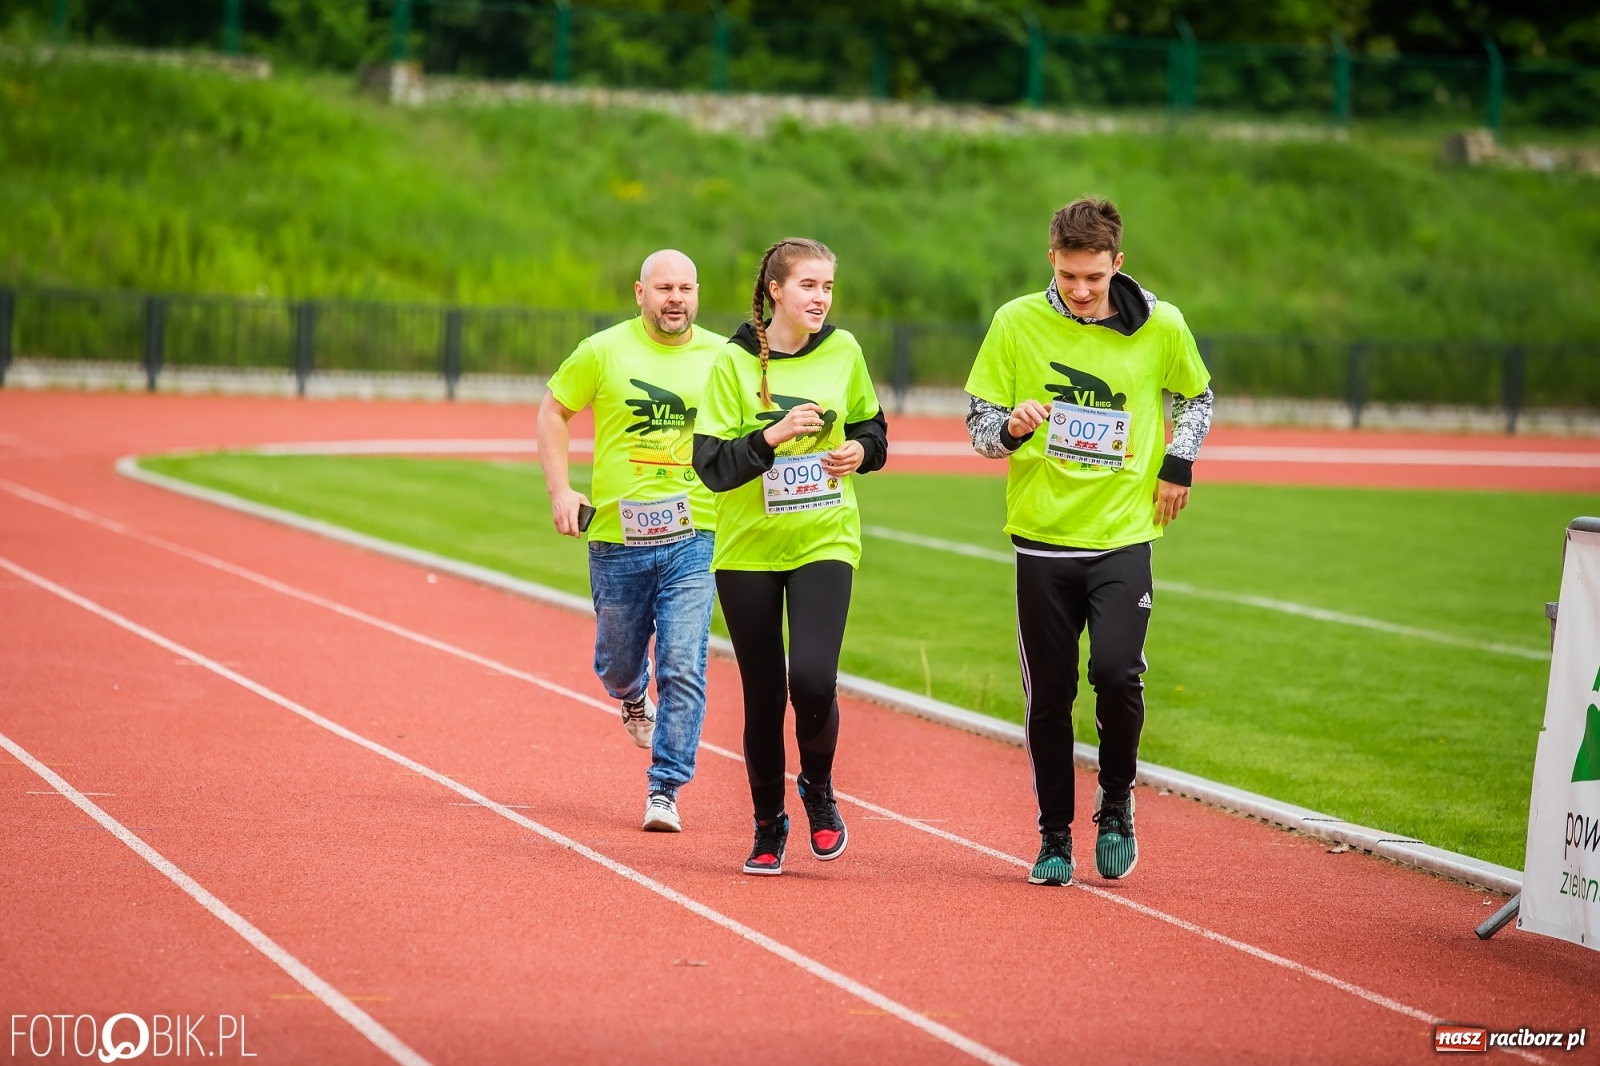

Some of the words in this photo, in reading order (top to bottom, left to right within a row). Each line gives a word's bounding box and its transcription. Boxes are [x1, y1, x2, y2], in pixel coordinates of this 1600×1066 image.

[1073, 390, 1095, 407] VI
[652, 404, 670, 419] VI
[651, 418, 663, 426] BEZ
[663, 419, 686, 427] BARIER
[1069, 420, 1110, 441] 007
[1116, 421, 1124, 431] R
[784, 464, 822, 485] 090
[677, 502, 685, 510] R
[637, 510, 673, 527] 089
[1560, 864, 1600, 903] zielon
